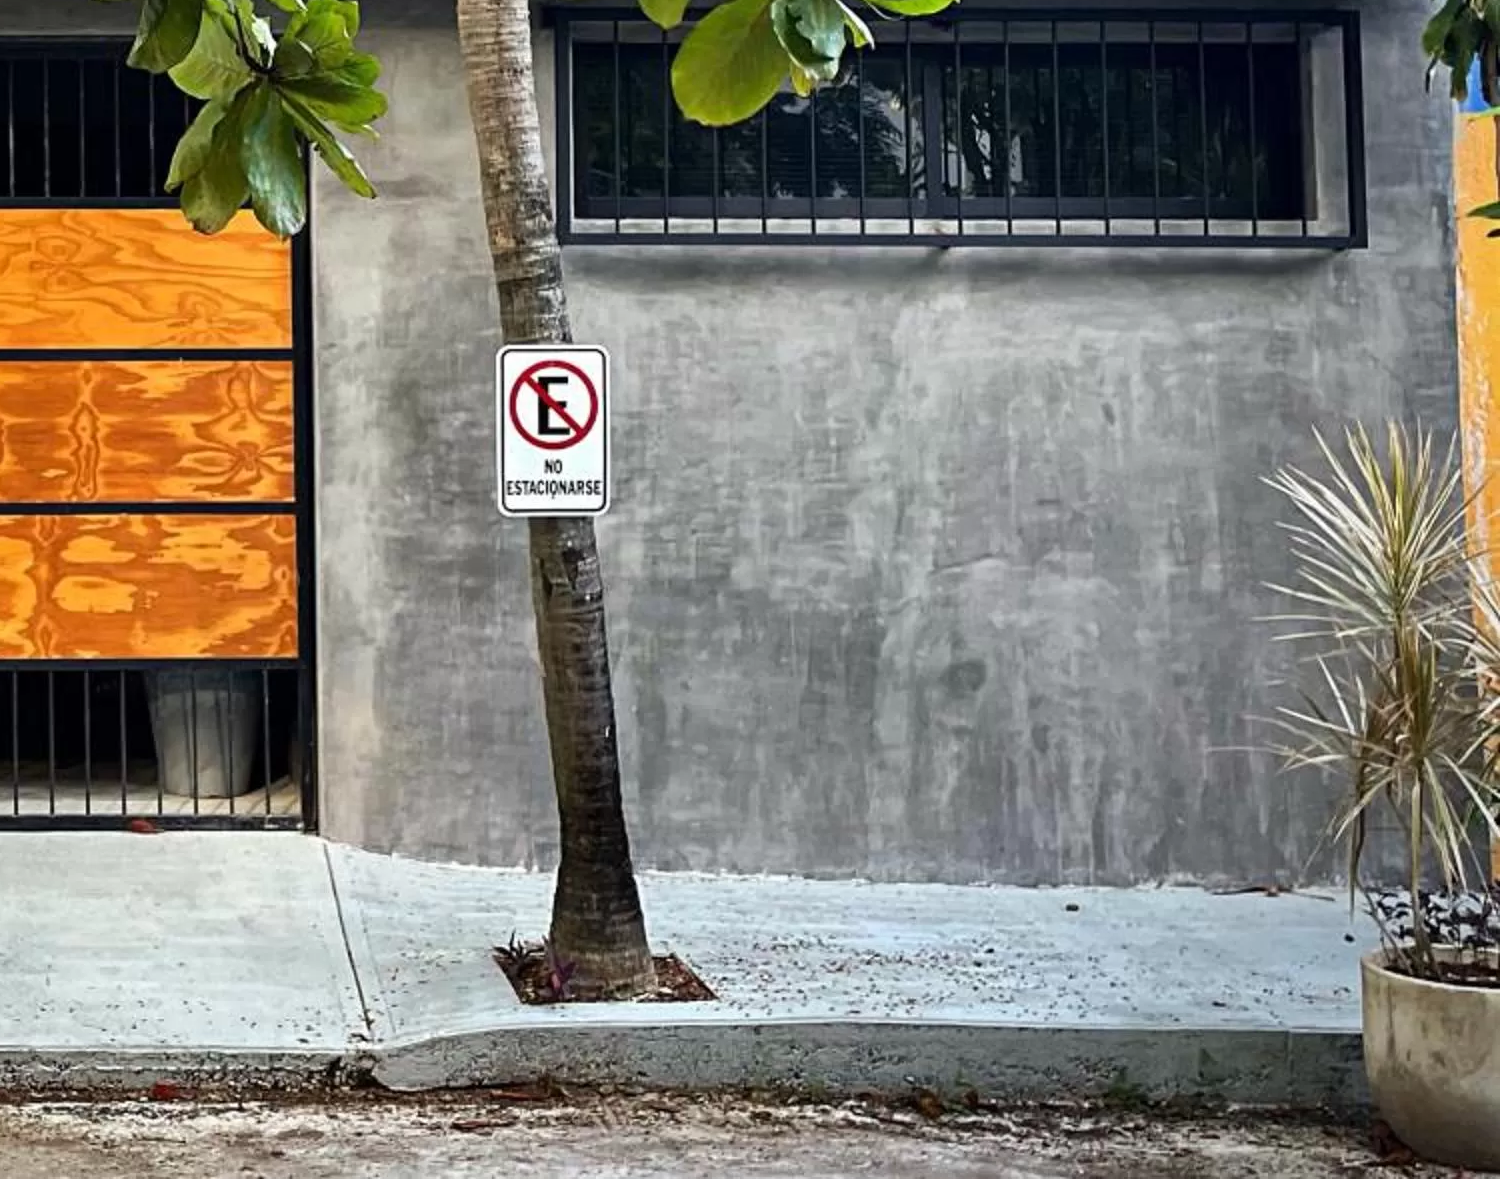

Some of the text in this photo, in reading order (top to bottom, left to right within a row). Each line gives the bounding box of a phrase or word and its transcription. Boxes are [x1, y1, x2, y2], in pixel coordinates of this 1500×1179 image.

[538, 376, 570, 435] E
[544, 459, 563, 474] NO
[507, 480, 601, 496] ESTACIONARSE
